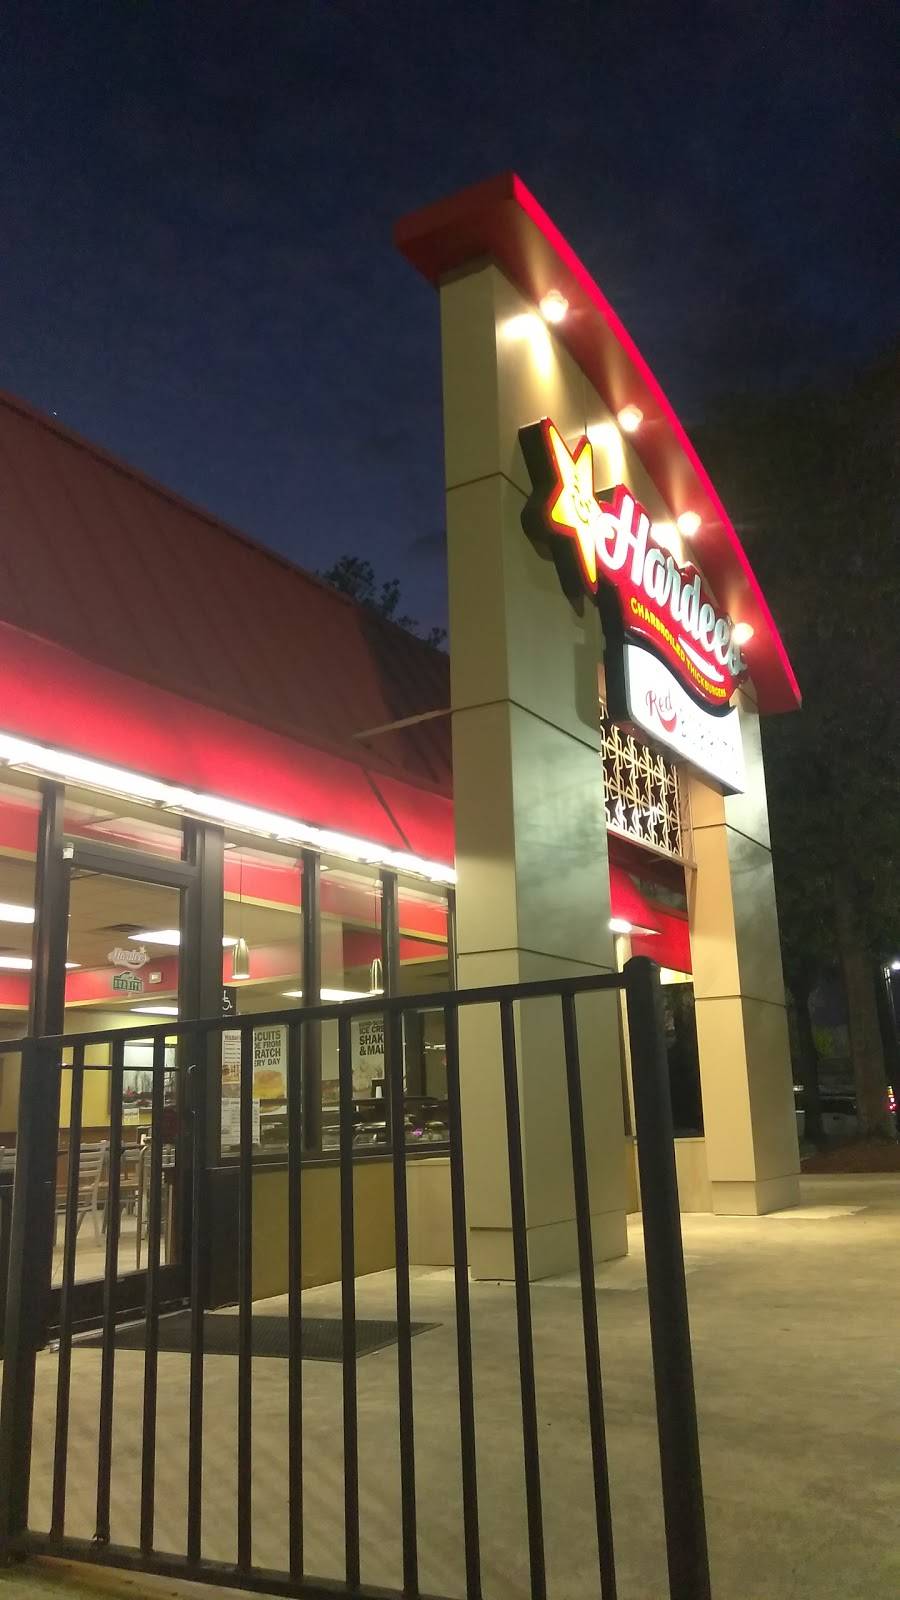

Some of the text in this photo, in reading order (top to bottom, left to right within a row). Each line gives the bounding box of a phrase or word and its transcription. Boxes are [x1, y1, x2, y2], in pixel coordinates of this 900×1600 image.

[595, 494, 746, 676] Hardee's
[630, 597, 686, 662] CHARBROILED
[645, 688, 676, 727] Red
[263, 1040, 281, 1049] FROM
[359, 1045, 366, 1056] &
[267, 1058, 281, 1066] DAY
